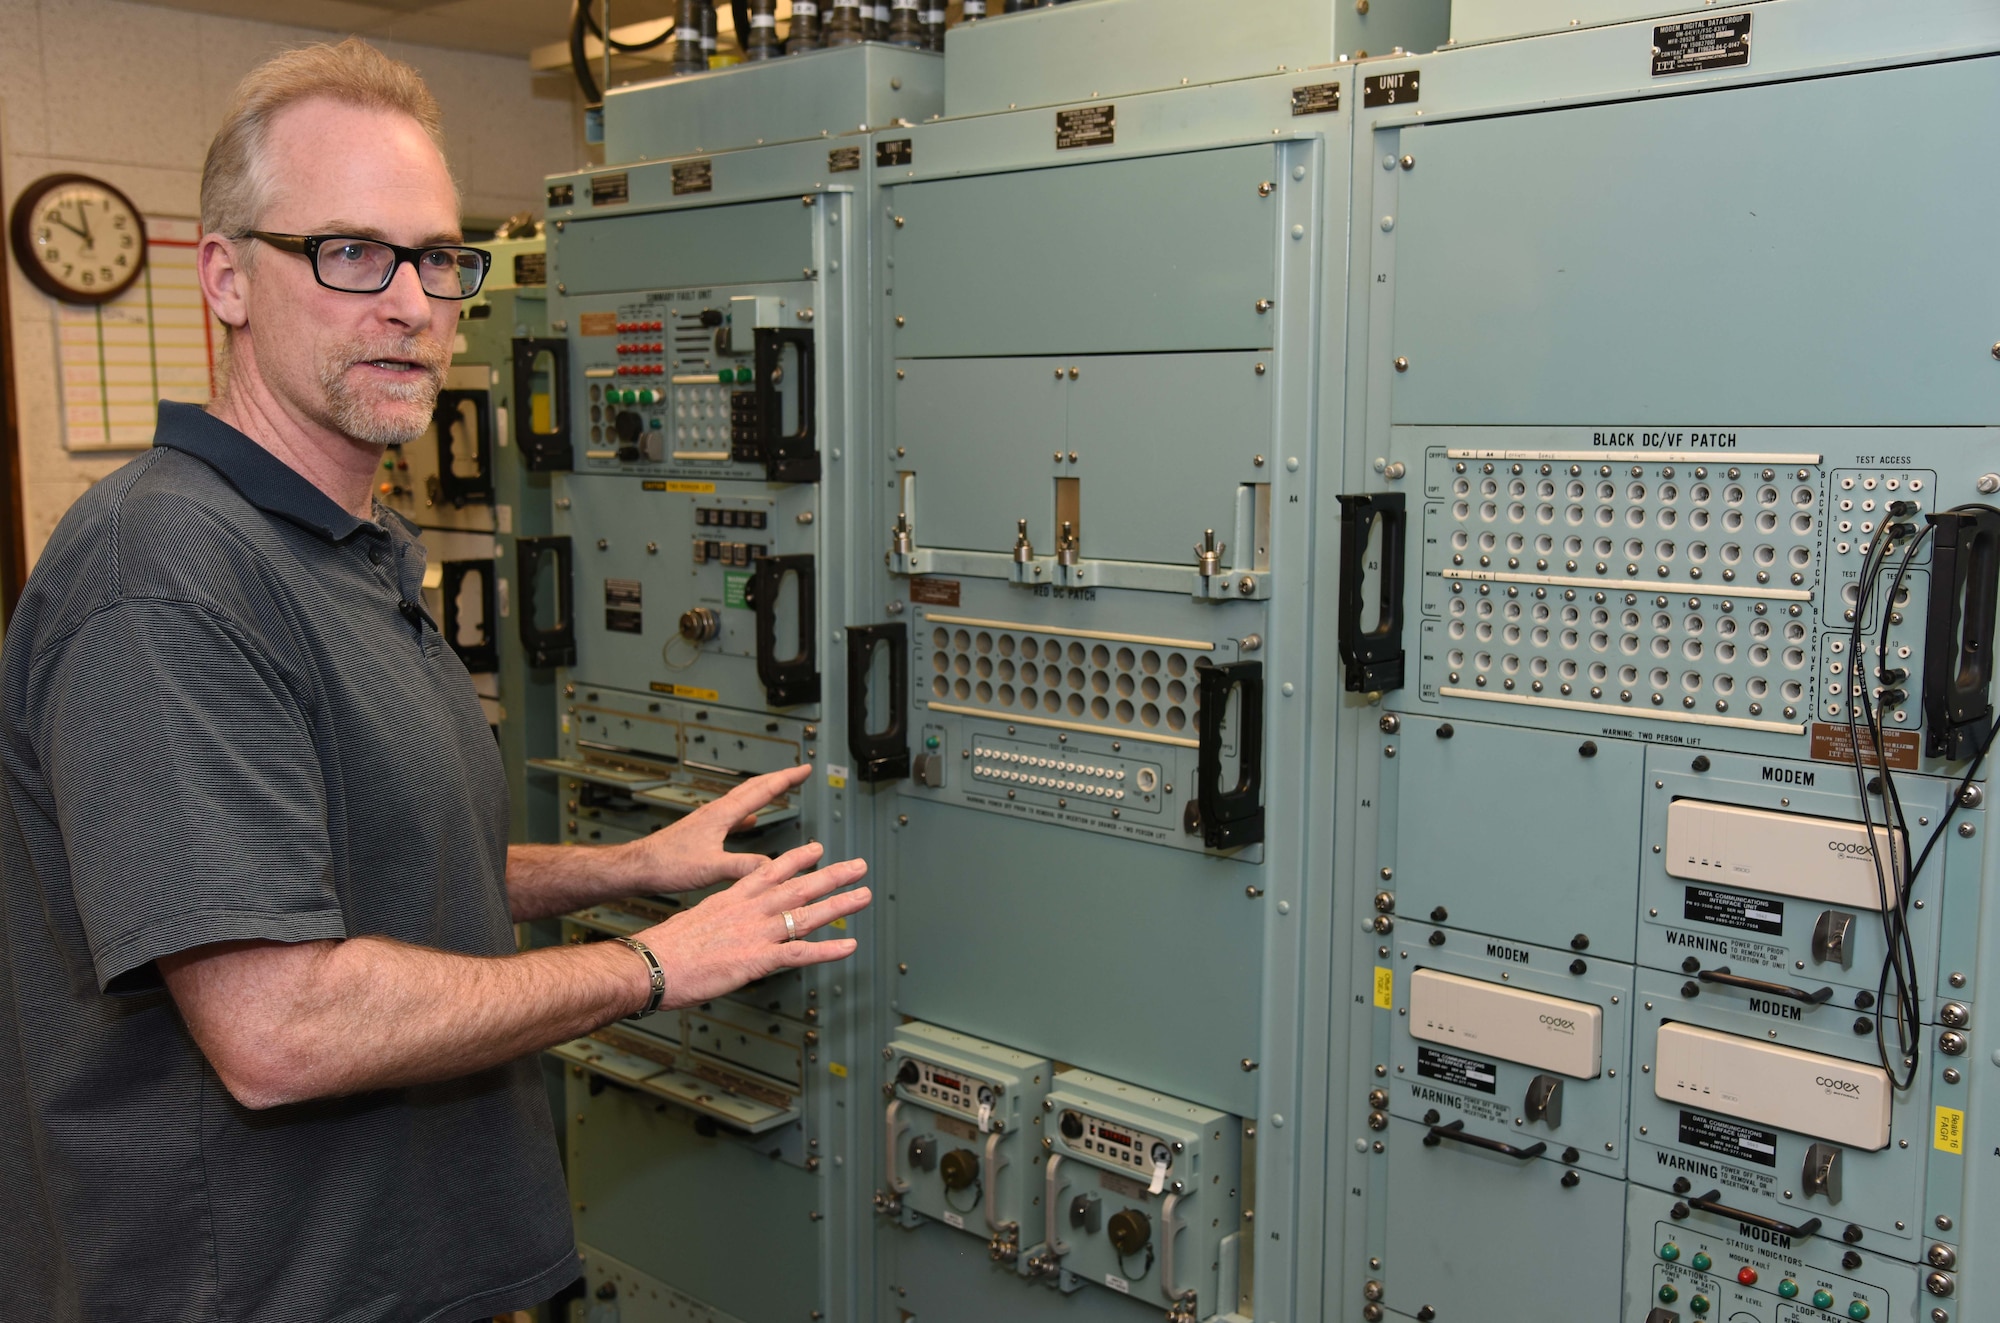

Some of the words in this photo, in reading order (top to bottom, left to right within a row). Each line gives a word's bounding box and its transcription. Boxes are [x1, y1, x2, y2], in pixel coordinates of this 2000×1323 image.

[1660, 25, 1681, 34] MODEM
[1683, 22, 1705, 30] DIGITAL
[1708, 18, 1723, 26] DATA
[1724, 15, 1744, 24] GROUP
[1656, 60, 1676, 71] ITT
[1379, 74, 1405, 90] UNIT
[1388, 89, 1395, 104] 3
[120, 233, 133, 249] 3
[114, 254, 126, 266] 4
[62, 262, 74, 278] 7
[81, 270, 95, 286] 6
[100, 266, 113, 281] 5
[1377, 273, 1386, 283] A2
[1593, 432, 1634, 447] BLACK
[1642, 432, 1683, 448] DC/VF
[1691, 433, 1736, 447] PATCH
[1856, 456, 1875, 464] TEST
[1879, 456, 1911, 464] ACCESS
[1289, 495, 1298, 503] A4
[1818, 471, 1826, 516] BLACK
[1817, 520, 1823, 537] DC
[1368, 561, 1378, 570] A3
[1814, 541, 1822, 586] PATCH
[1842, 570, 1856, 578] TEST
[1712, 603, 1719, 611] 10
[1810, 656, 1816, 672] VF
[1602, 728, 1634, 738] WARNING:
[1638, 731, 1652, 740] TWO
[1656, 733, 1683, 744] PERSON
[1686, 737, 1701, 746] LIFT
[1762, 766, 1815, 787] MODEM
[1361, 800, 1370, 808] A4
[1123, 825, 1133, 833] TWO
[1135, 827, 1154, 838] PERSON
[1155, 832, 1165, 840] LIFT
[1828, 841, 1874, 856] codex
[1709, 897, 1741, 907] INTERFACE
[1714, 893, 1769, 907] COMMUNICATIONS
[1666, 930, 1728, 955] WARNING
[1731, 940, 1751, 949] POWER
[1754, 943, 1764, 951] OFF
[1767, 946, 1784, 955] PRIOR
[1486, 944, 1529, 964] MODEM
[1730, 953, 1759, 964] INSERTION
[1773, 961, 1786, 970] UNIT
[1741, 949, 1766, 959] REMOVAL
[1749, 997, 1801, 1022] MODEM
[1539, 1014, 1575, 1030] codex
[1816, 1076, 1861, 1095] codex
[1411, 1084, 1462, 1109] WARNING
[1692, 1115, 1707, 1124] DATA
[1709, 1120, 1762, 1138] COMMUNICATIONS
[1703, 1123, 1735, 1137] INTERFACE
[1737, 1132, 1751, 1140] UNIT
[1940, 1116, 1949, 1141] FAGR
[1950, 1114, 1960, 1136] Beale
[1950, 1139, 1958, 1149] 16
[1657, 1151, 1718, 1179] WARNING
[1721, 1165, 1740, 1175] POWER
[1743, 1170, 1753, 1178] OFF
[1756, 1174, 1773, 1184] PRIOR
[1730, 1175, 1756, 1186] REMOVAL
[1759, 1181, 1767, 1189] OR
[1720, 1180, 1749, 1191] INSERTION
[1751, 1186, 1759, 1194] OF
[1762, 1189, 1775, 1198] UNIT
[1740, 1222, 1791, 1250] MODEM
[1725, 1238, 1754, 1253] STATUS
[1757, 1247, 1802, 1268] INDICATORS
[1729, 1253, 1750, 1265] MODEM
[1752, 1261, 1770, 1271] FAULT
[1661, 1269, 1680, 1279] POWER
[1665, 1263, 1708, 1281] OPERATIONS
[1784, 1270, 1796, 1278] DSR
[1695, 1286, 1709, 1295] HIGH
[1701, 1282, 1715, 1291] RATE
[1817, 1280, 1833, 1290] CARR
[1734, 1293, 1743, 1301] XM
[1746, 1297, 1762, 1307] LEVEL
[1853, 1291, 1869, 1302] QUAL
[1694, 1313, 1707, 1321] LOW
[1791, 1313, 1799, 1321] DC
